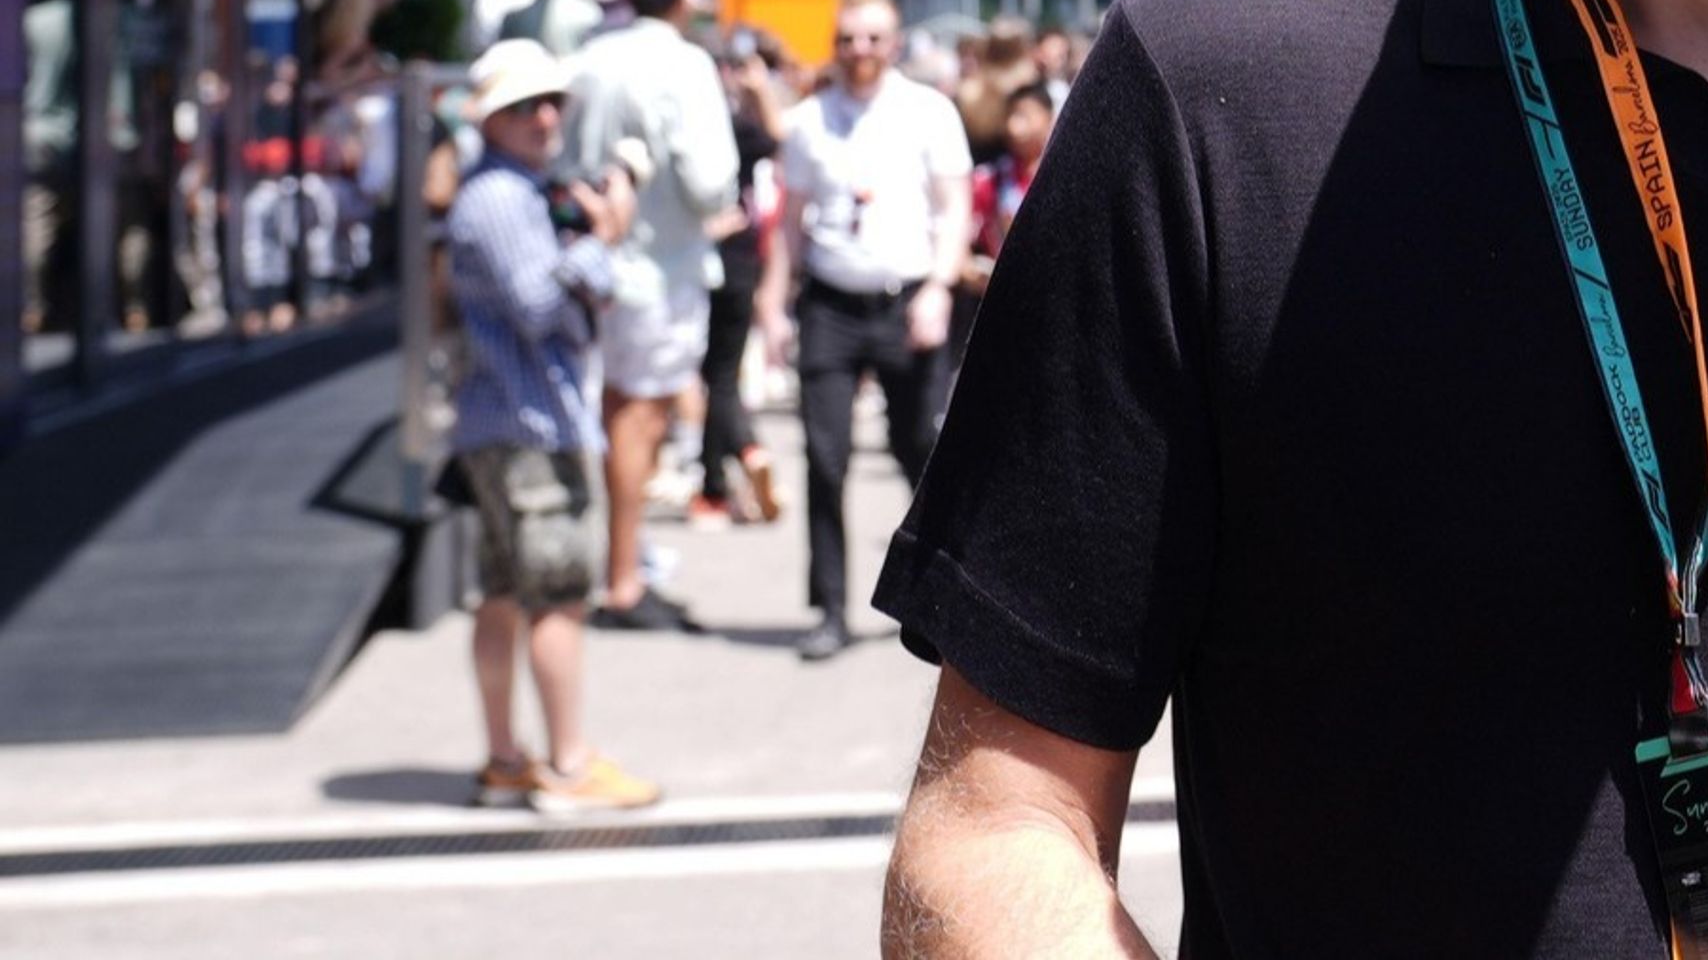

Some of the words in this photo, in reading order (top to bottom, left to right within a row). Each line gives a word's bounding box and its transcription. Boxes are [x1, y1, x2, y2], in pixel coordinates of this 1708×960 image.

[1612, 61, 1660, 136] Barcelona
[1554, 166, 1594, 252] SUNDAY
[1635, 141, 1673, 232] SPAIN
[1608, 363, 1643, 463] PADDOCK
[1631, 407, 1652, 461] CLUB
